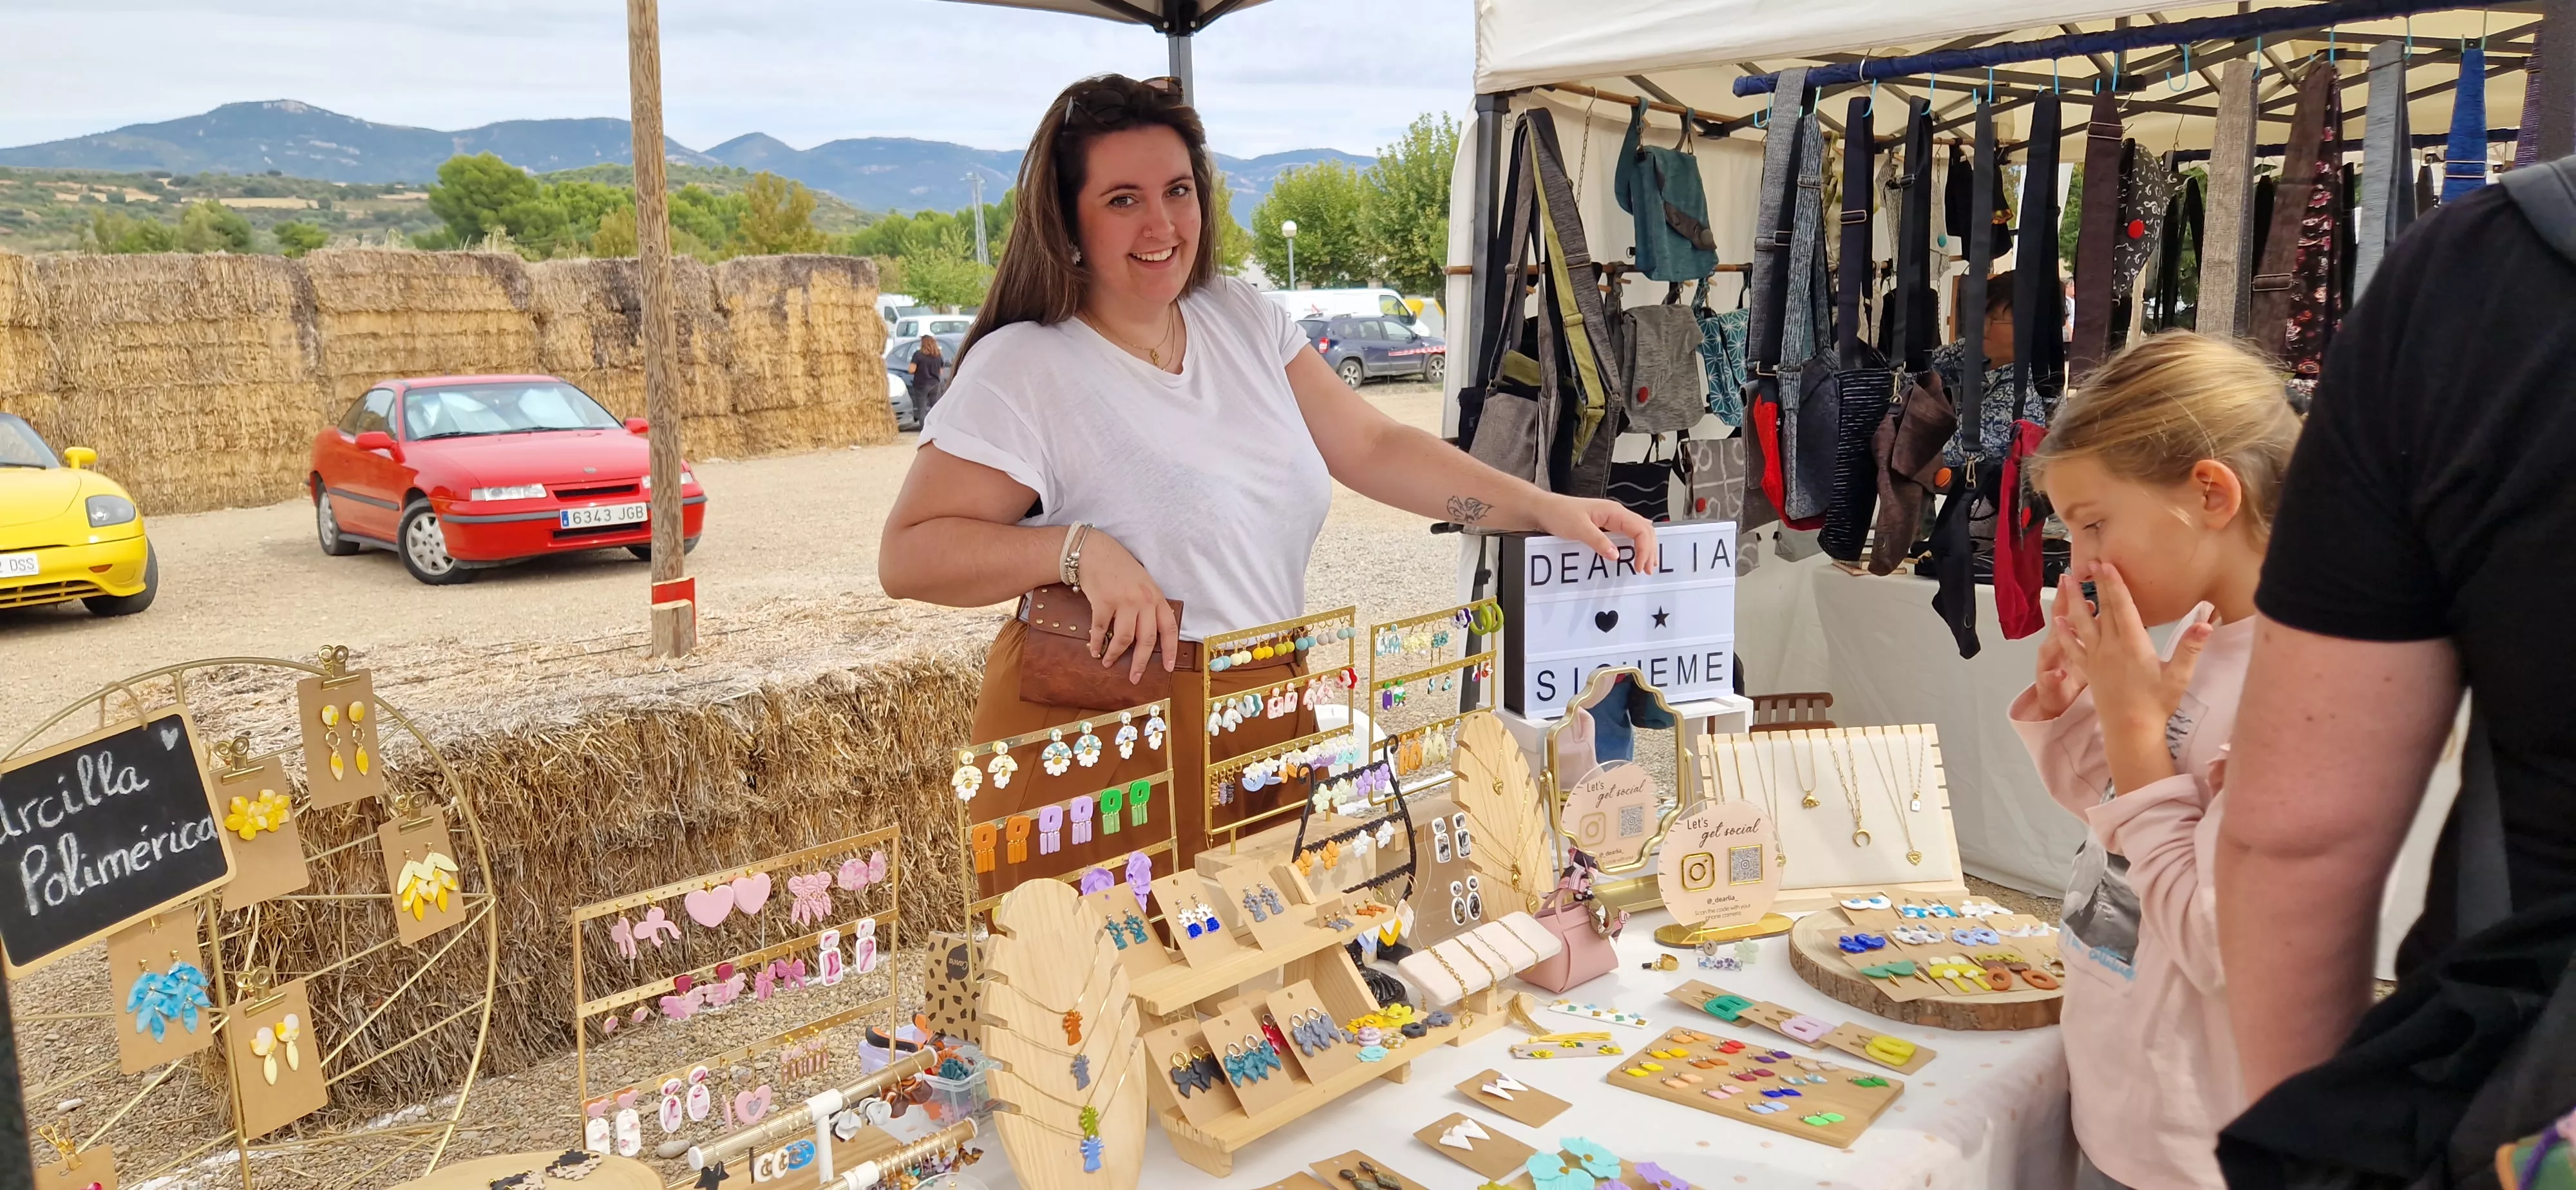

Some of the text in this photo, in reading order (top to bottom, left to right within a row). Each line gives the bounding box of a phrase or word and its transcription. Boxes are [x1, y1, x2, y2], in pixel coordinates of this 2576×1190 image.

[573, 506, 644, 524] 6343 JGB
[10, 558, 34, 571] DSS
[1537, 652, 1723, 701] SIEME
[1587, 780, 1604, 793] Let's
[1595, 779, 1646, 808] get social
[1687, 817, 1709, 830] Let's
[1699, 818, 1761, 848] get social
[20, 815, 219, 916] Polimérica
